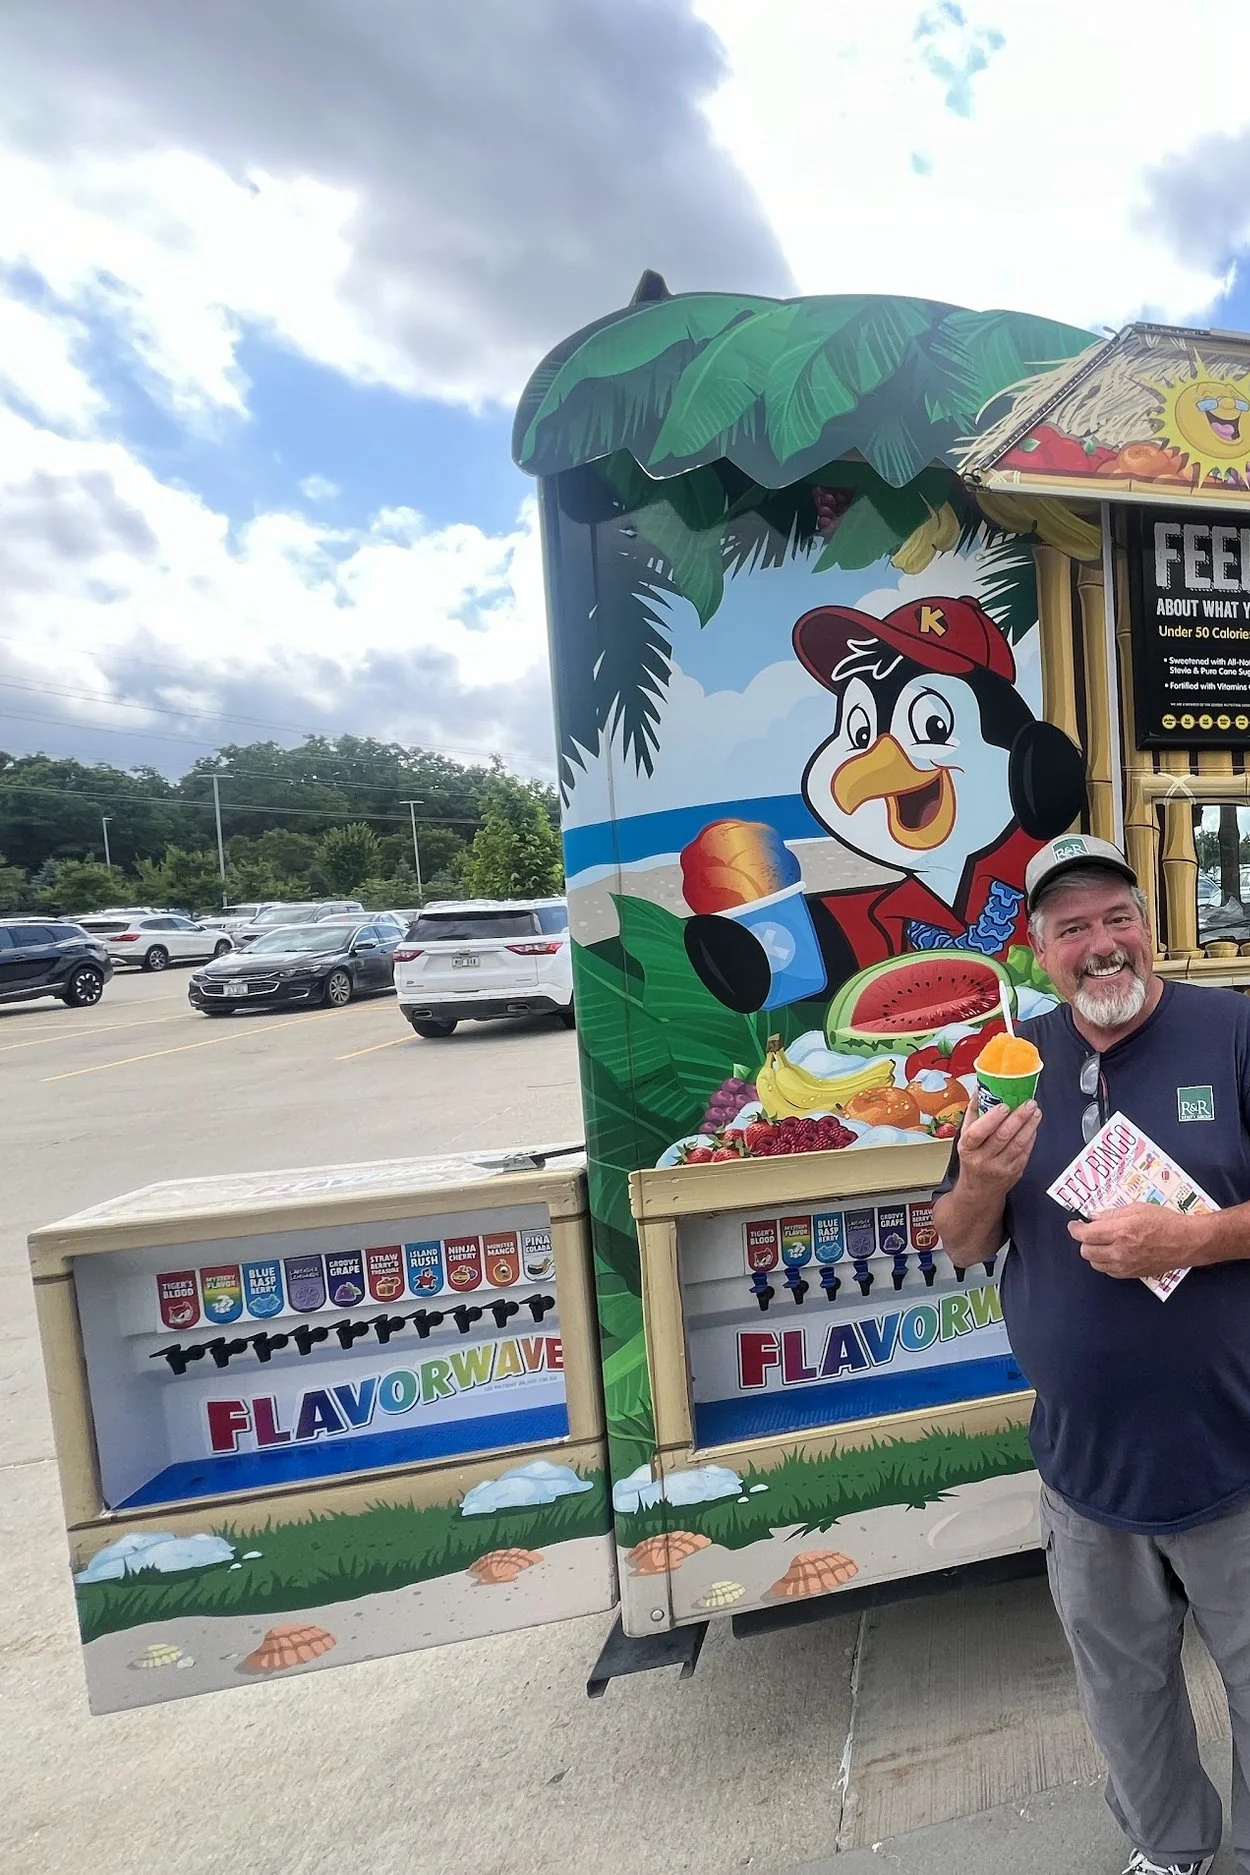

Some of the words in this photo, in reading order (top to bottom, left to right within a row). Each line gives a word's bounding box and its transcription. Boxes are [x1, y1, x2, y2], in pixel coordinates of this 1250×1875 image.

[1156, 598, 1199, 617] ABOUT
[1202, 600, 1239, 618] WHAT
[920, 606, 946, 637] K
[1158, 625, 1193, 638] Under
[1195, 626, 1210, 639] 50
[1169, 656, 1209, 665] Sweetened
[1210, 658, 1226, 666] with
[1193, 667, 1199, 675] &
[1170, 682, 1199, 690] Fortified
[1200, 682, 1216, 690] with
[1217, 683, 1247, 691] Vitamins
[1055, 844, 1086, 860] R&R
[1181, 1100, 1211, 1116] R&R
[1085, 1124, 1137, 1180] BINGO
[880, 1212, 904, 1220] GROOVY
[817, 1218, 838, 1228] BLUE
[881, 1218, 904, 1228] GRAPE
[750, 1228, 774, 1237] TIGER'S
[785, 1229, 808, 1237] FLAVOR
[818, 1226, 839, 1236] RASP
[525, 1233, 550, 1246] PIÑA
[750, 1235, 775, 1245] BLOOD
[409, 1248, 437, 1258] ISLAND
[448, 1244, 476, 1255] NINJA
[488, 1247, 515, 1256] MANGO
[370, 1253, 398, 1263] STRAW
[411, 1256, 438, 1267] RUSH
[449, 1252, 476, 1262] CHERRY
[329, 1258, 359, 1267] GROOVY
[248, 1267, 276, 1278] BLUE
[330, 1265, 360, 1276] GRAPE
[371, 1268, 399, 1276] TREASURE
[162, 1280, 193, 1290] TIGER'S
[207, 1280, 236, 1289] FLAVOR
[250, 1276, 276, 1288] RASP
[163, 1288, 194, 1299] BLOOD
[250, 1285, 277, 1295] BERRY
[206, 1335, 564, 1454] FLAVORWAVE
